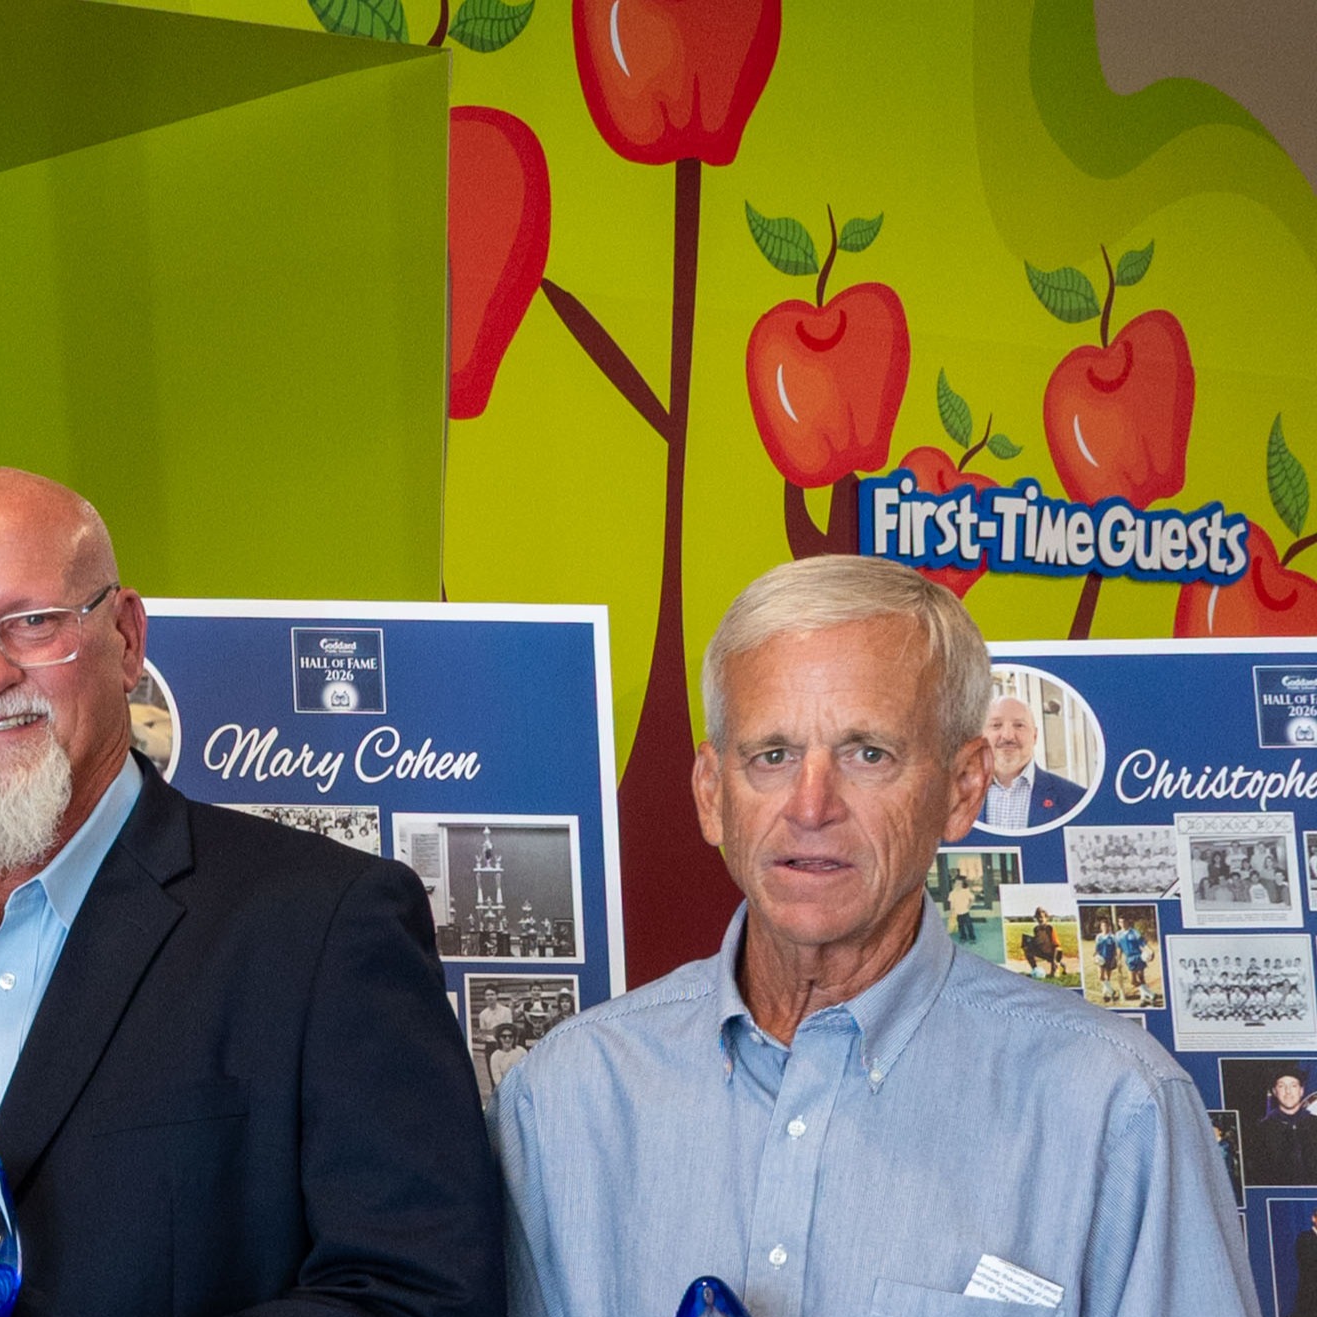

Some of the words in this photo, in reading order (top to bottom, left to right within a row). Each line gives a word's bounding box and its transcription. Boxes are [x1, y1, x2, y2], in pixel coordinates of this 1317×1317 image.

[1098, 505, 1248, 576] Guests
[319, 638, 357, 650] Goddard
[300, 657, 330, 669] HALL
[331, 658, 346, 668] OF
[347, 657, 378, 670] FAME
[325, 669, 354, 681] 2026
[1263, 694, 1293, 705] HALL
[1294, 694, 1308, 704] OF
[1288, 706, 1317, 717] 2026
[203, 723, 345, 793] Mary
[355, 725, 481, 784] Cohen
